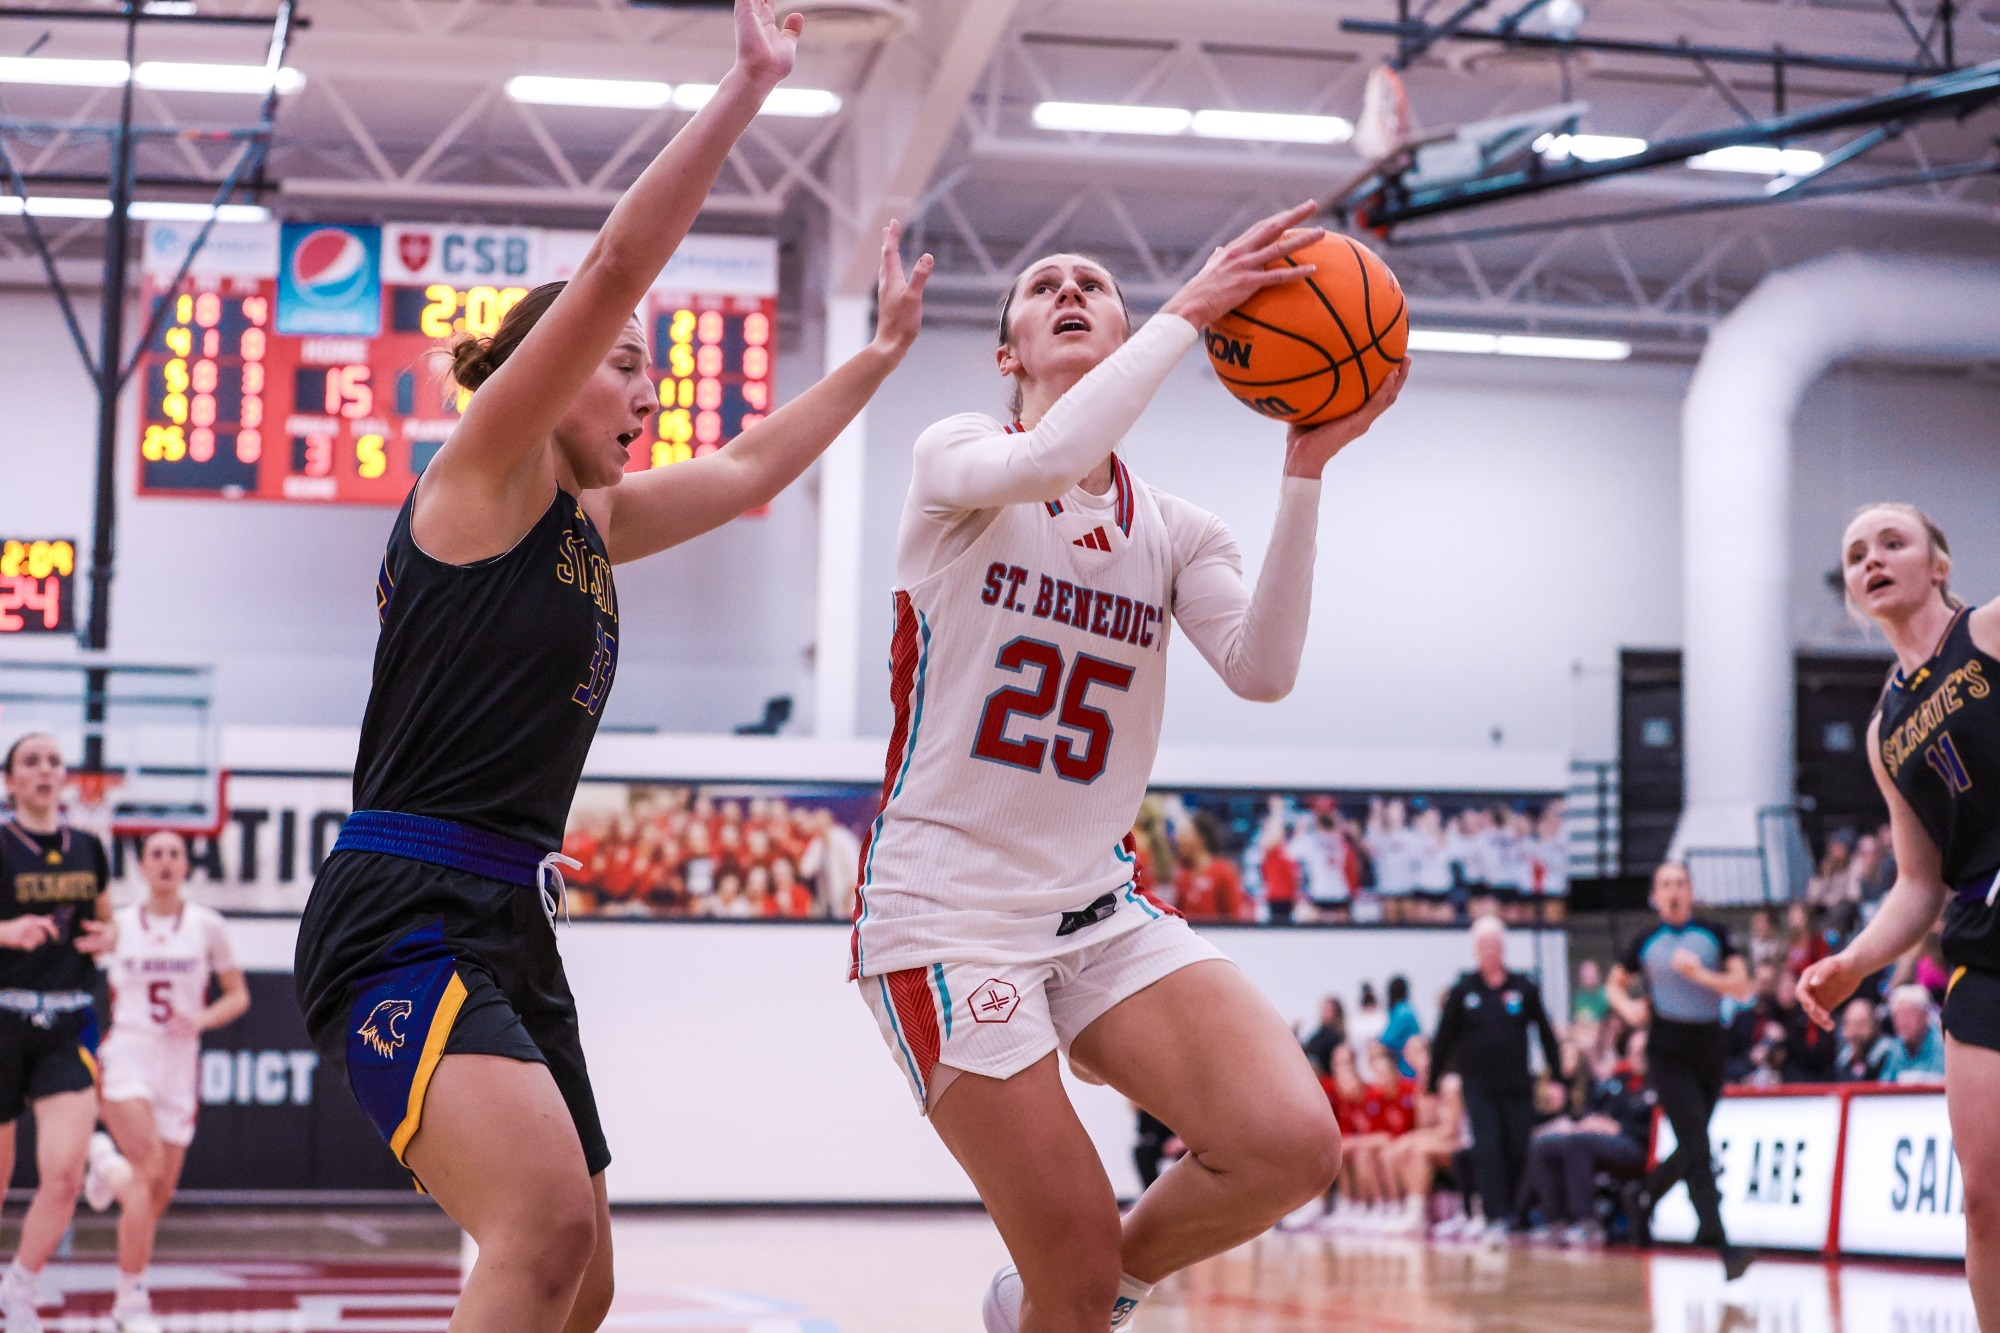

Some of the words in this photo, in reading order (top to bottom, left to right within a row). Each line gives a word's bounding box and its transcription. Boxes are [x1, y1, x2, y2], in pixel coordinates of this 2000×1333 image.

[441, 233, 529, 276] CSB
[324, 364, 374, 419] 15
[304, 431, 333, 477] 3
[356, 433, 387, 479] 5
[0, 576, 60, 631] 24
[981, 561, 1028, 614] ST.
[970, 635, 1136, 785] 25
[1925, 730, 1972, 797] 11
[147, 981, 175, 1024] 5
[202, 1050, 318, 1105] DICT
[1745, 1140, 1807, 1204] ARE
[1892, 1137, 1965, 1214] SAI
